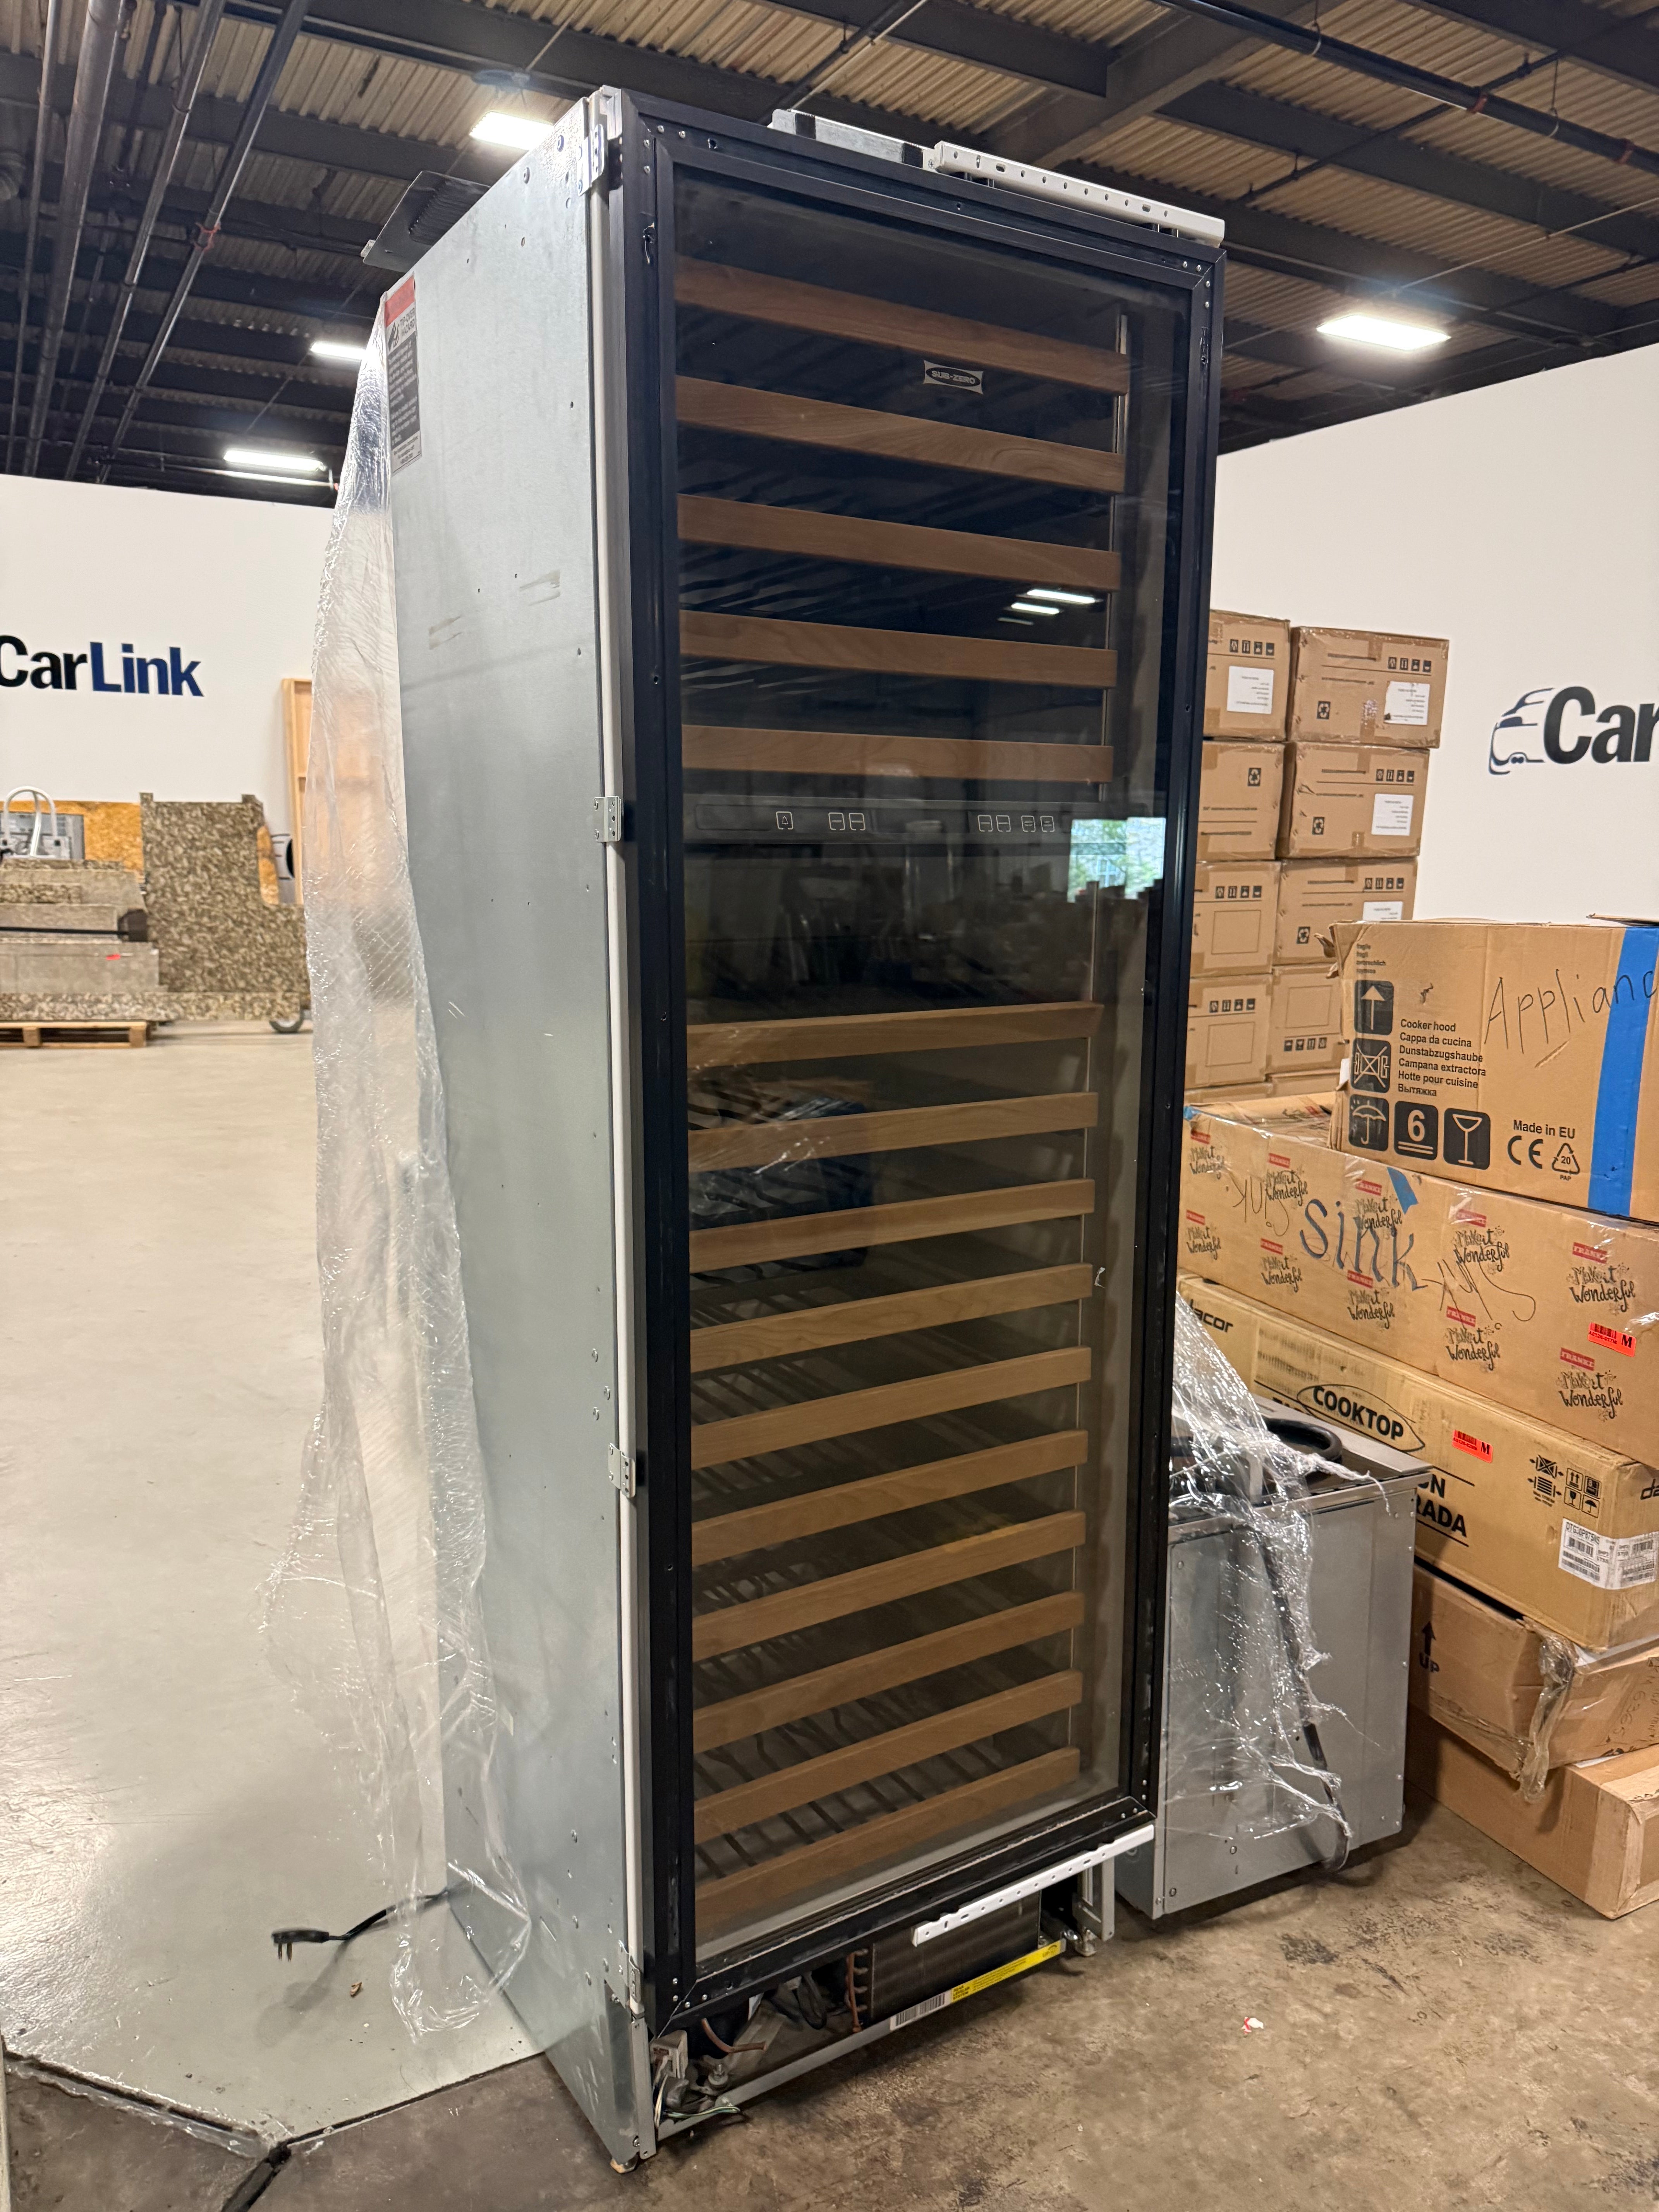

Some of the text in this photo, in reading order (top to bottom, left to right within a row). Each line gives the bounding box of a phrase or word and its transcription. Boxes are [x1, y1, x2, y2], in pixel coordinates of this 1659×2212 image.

[0, 635, 204, 697] CarLink
[1400, 1018, 1456, 1032] Cooker hood
[1400, 1032, 1472, 1048] Cappa da cucina
[1399, 1045, 1483, 1062] Dunstabzugshaube
[1398, 1058, 1486, 1076] Campana extractora
[1398, 1070, 1479, 1089] Hotte pour cuisine
[1398, 1083, 1437, 1097] Вытяжка
[1408, 1109, 1425, 1142] 6
[1513, 1119, 1575, 1139] Made in EU
[1561, 1156, 1571, 1165] 20
[1266, 1181, 1308, 1207] Wonderful
[1299, 1199, 1428, 1291] Sink
[1482, 1228, 1494, 1245] it
[1453, 1242, 1510, 1272] Wonderful
[1261, 1266, 1303, 1293] Wonderful
[1602, 1265, 1617, 1283] it
[1569, 1279, 1635, 1312] Wonderful
[1347, 1301, 1395, 1329] Wonderful
[1473, 1328, 1484, 1344] it
[1621, 1334, 1632, 1348] M
[1445, 1341, 1501, 1371] Wonderful
[1591, 1372, 1605, 1390] it
[1313, 1385, 1404, 1441] COOKTOP
[1558, 1387, 1623, 1419] Wonderful
[1480, 1442, 1490, 1455] M
[1418, 1474, 1445, 1498] N
[1419, 1652, 1440, 1673] UP
